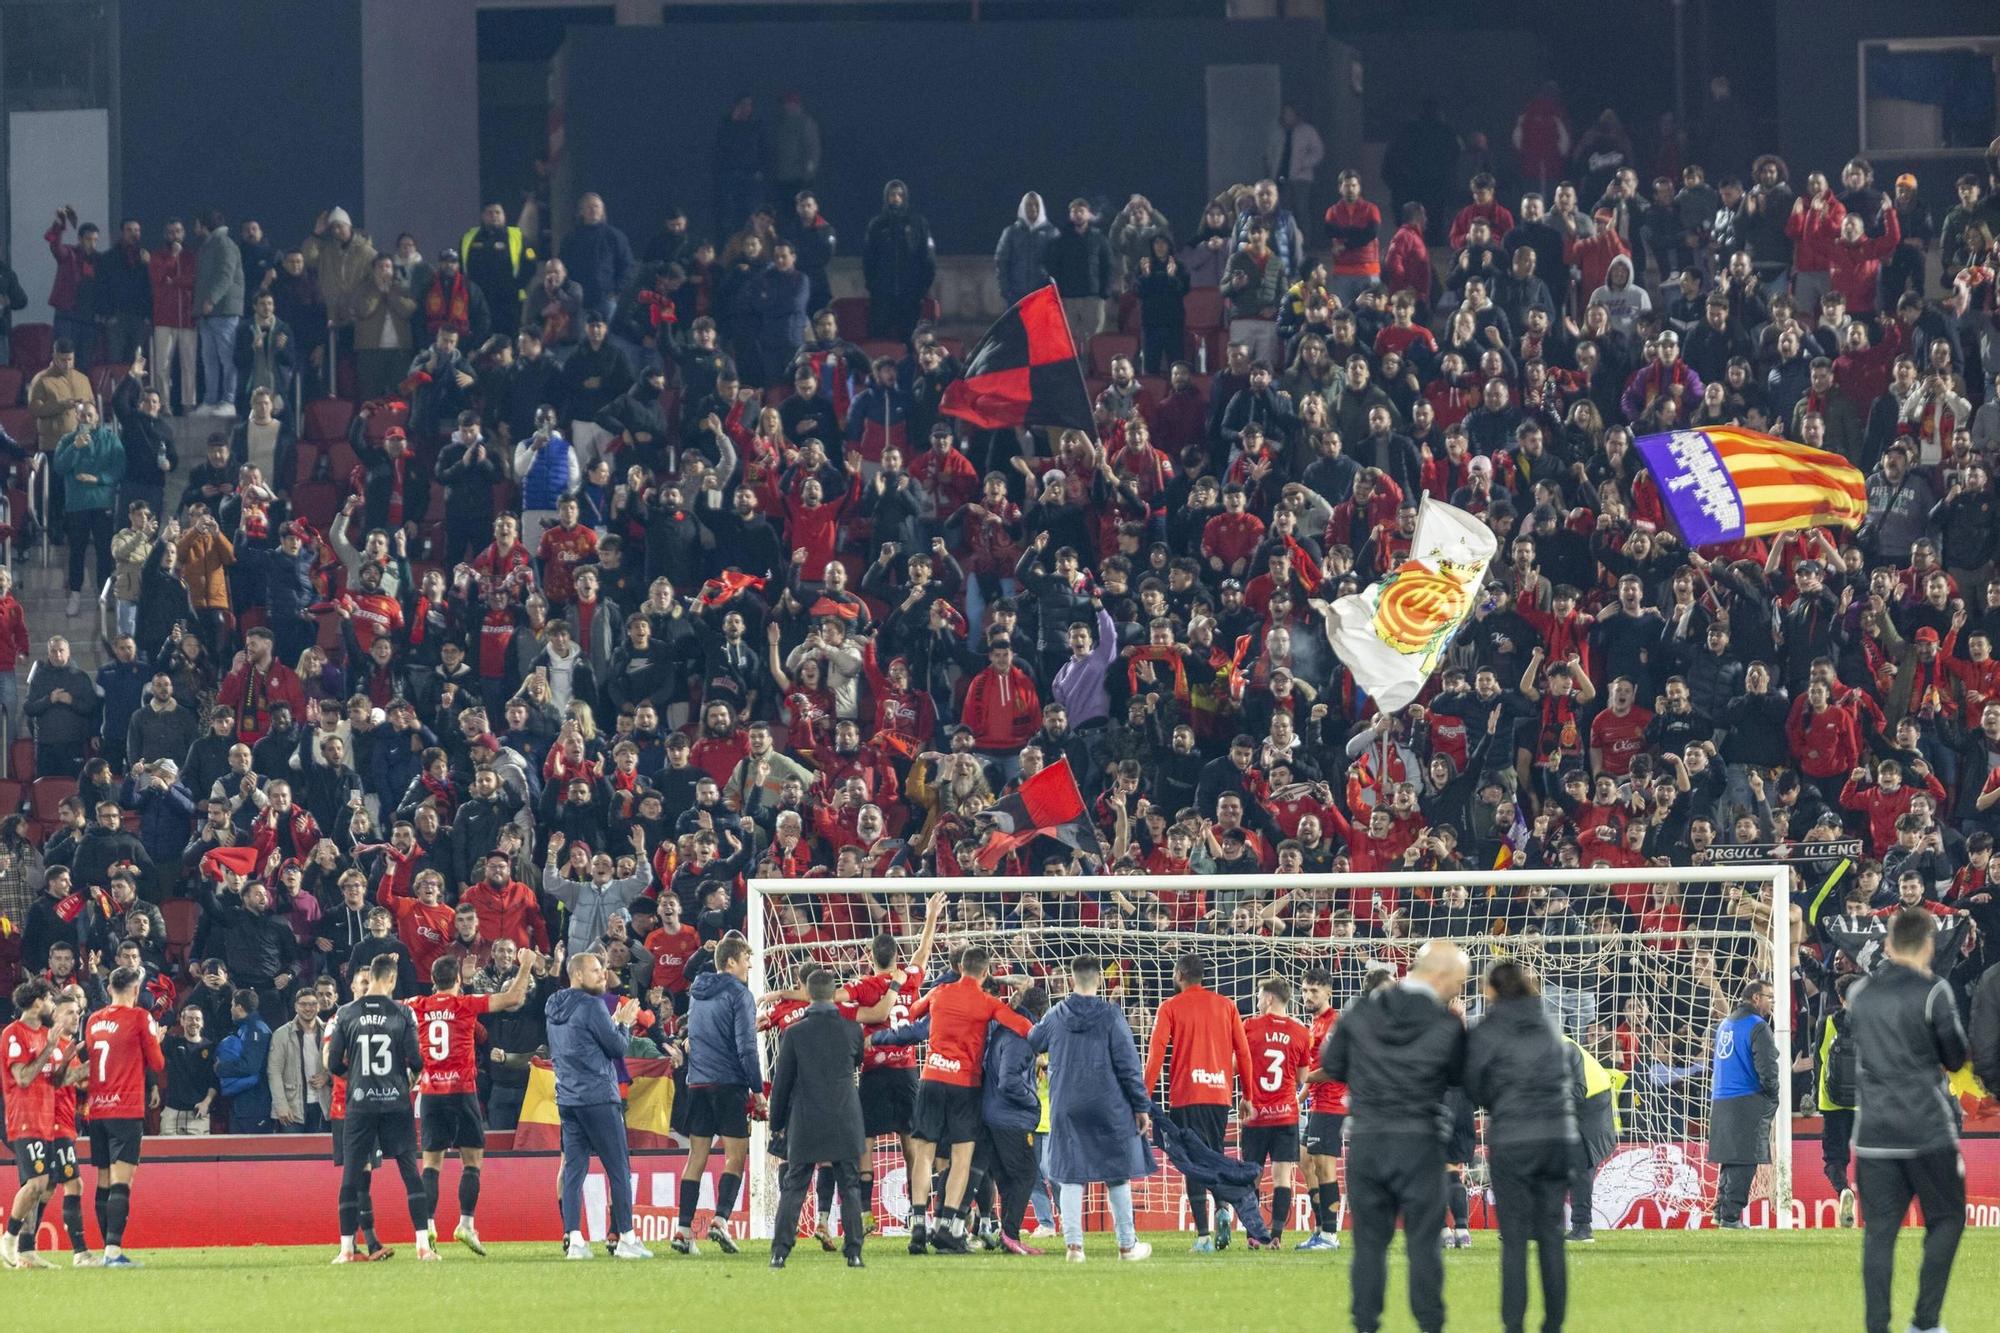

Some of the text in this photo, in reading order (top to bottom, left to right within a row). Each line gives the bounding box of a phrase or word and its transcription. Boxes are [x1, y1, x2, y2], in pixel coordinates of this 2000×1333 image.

[428, 1020, 450, 1061] 9
[1265, 1031, 1291, 1045] LATO
[93, 1040, 110, 1082] 7
[356, 1034, 393, 1076] 13
[430, 1070, 461, 1081] ALUA
[1191, 1068, 1225, 1084] fibwi
[1259, 1049, 1286, 1092] 3
[365, 1086, 400, 1097] ALUA
[1259, 1103, 1293, 1115] ALUA
[26, 1141, 46, 1162] 12
[57, 1146, 76, 1166] 14
